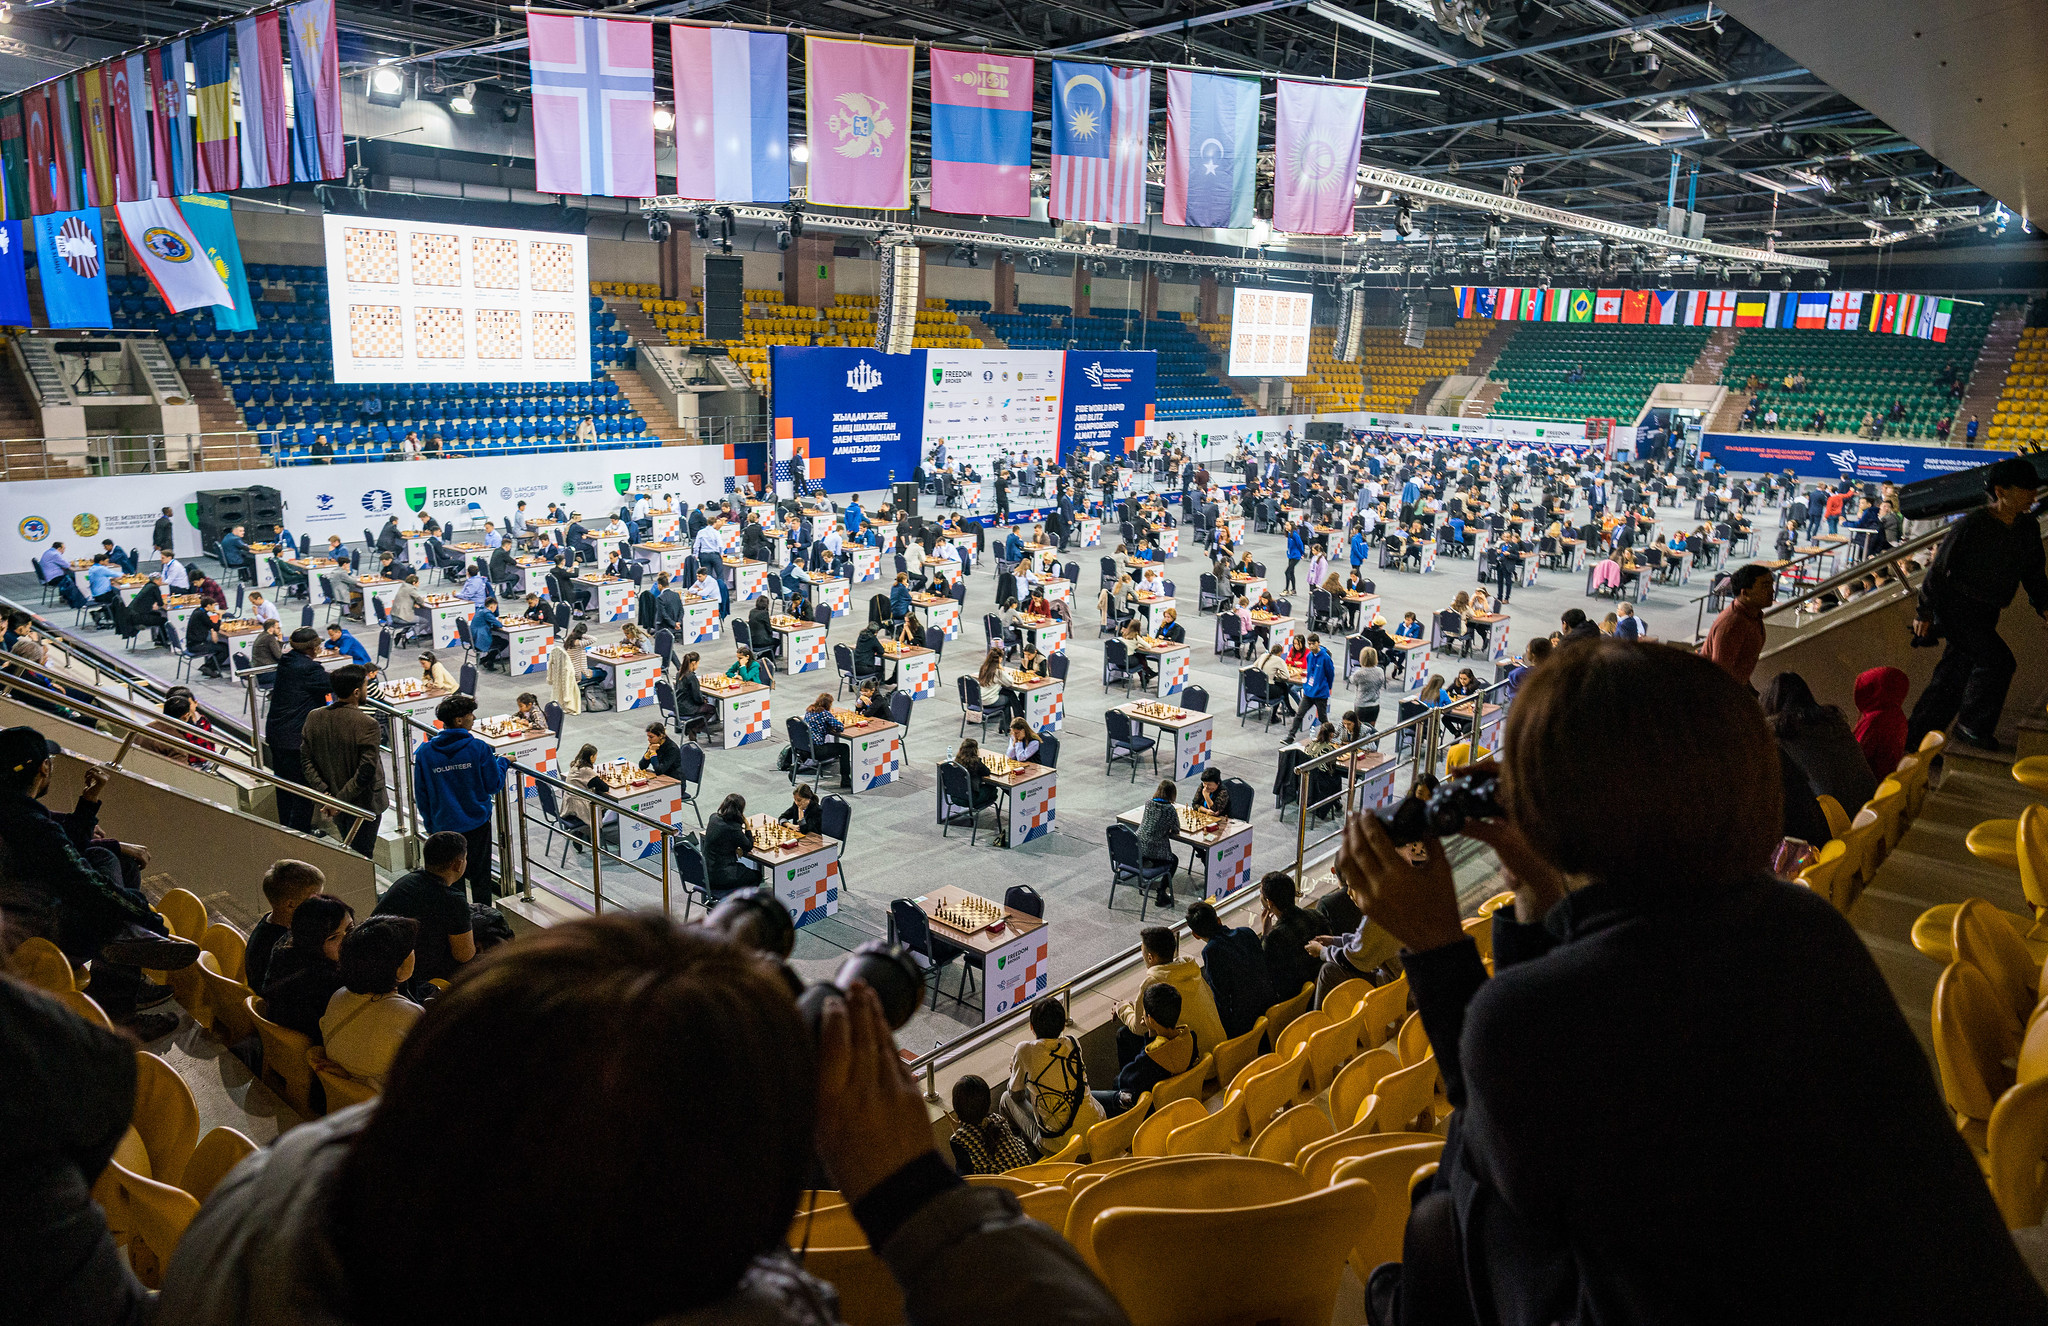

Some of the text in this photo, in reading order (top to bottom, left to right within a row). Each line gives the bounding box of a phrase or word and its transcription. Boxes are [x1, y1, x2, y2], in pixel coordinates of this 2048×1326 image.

[1075, 403, 1125, 413] FIDE WORLD RAPID
[1075, 413, 1104, 422] AND BLITZ
[1074, 422, 1119, 430] CHAMPIONSHIPS
[1074, 430, 1111, 440] ALMATY 2022
[864, 445, 881, 453] 2022
[636, 473, 679, 483] FREEDOM
[433, 486, 487, 499] FREEDOM
[434, 499, 466, 507] BROKER
[517, 747, 537, 755] FREEDOM
[432, 763, 472, 773] VOLUNTEER
[1027, 786, 1043, 794] FREEDOM
[641, 799, 662, 807] FREEDOM
[1224, 844, 1239, 854] FREEDOM
[797, 862, 818, 873] FREEDOM
[1008, 946, 1028, 960] FREEDOM
[1008, 956, 1020, 965] BROKER
